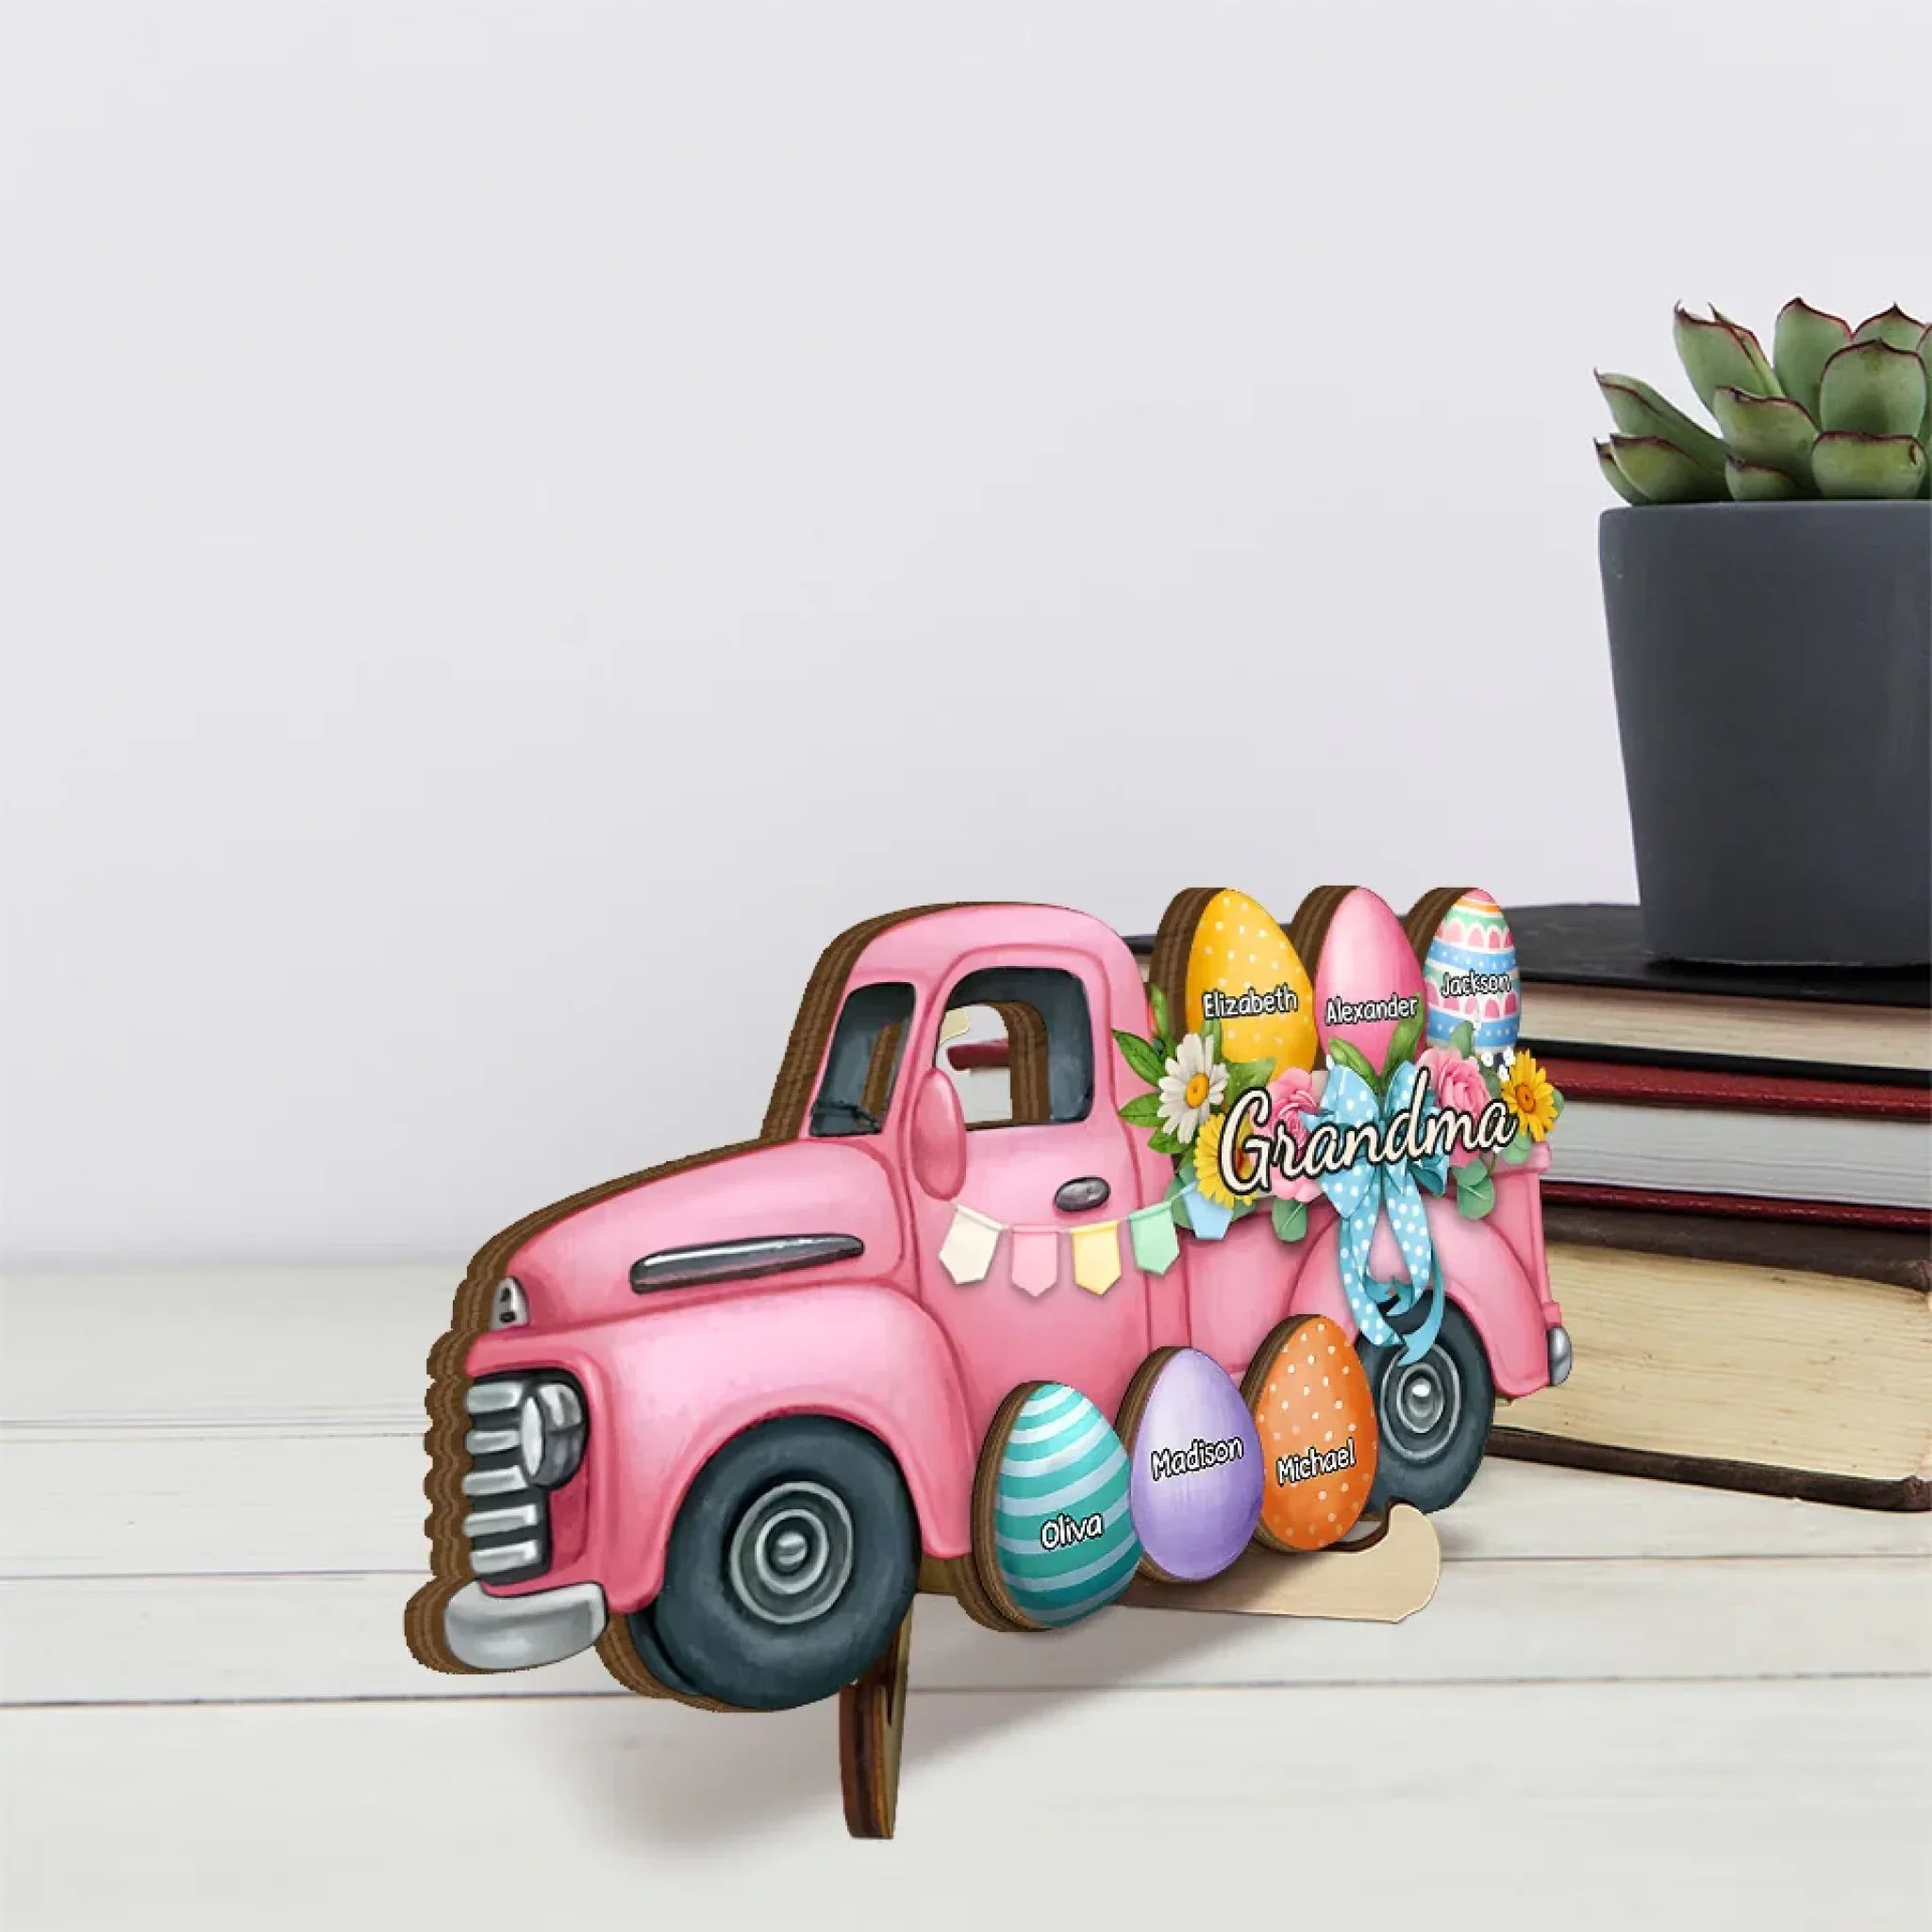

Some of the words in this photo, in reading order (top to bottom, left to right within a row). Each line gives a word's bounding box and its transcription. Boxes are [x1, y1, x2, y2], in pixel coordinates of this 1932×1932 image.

[1203, 984, 1298, 1019] Elizabeth
[1441, 970, 1510, 998] Jackson
[1324, 994, 1418, 1025] Alexander
[1220, 1067, 1517, 1194] Grandma
[1151, 1436, 1244, 1481] Madison
[1277, 1439, 1357, 1487] Michael
[1041, 1512, 1104, 1550] Oliva
